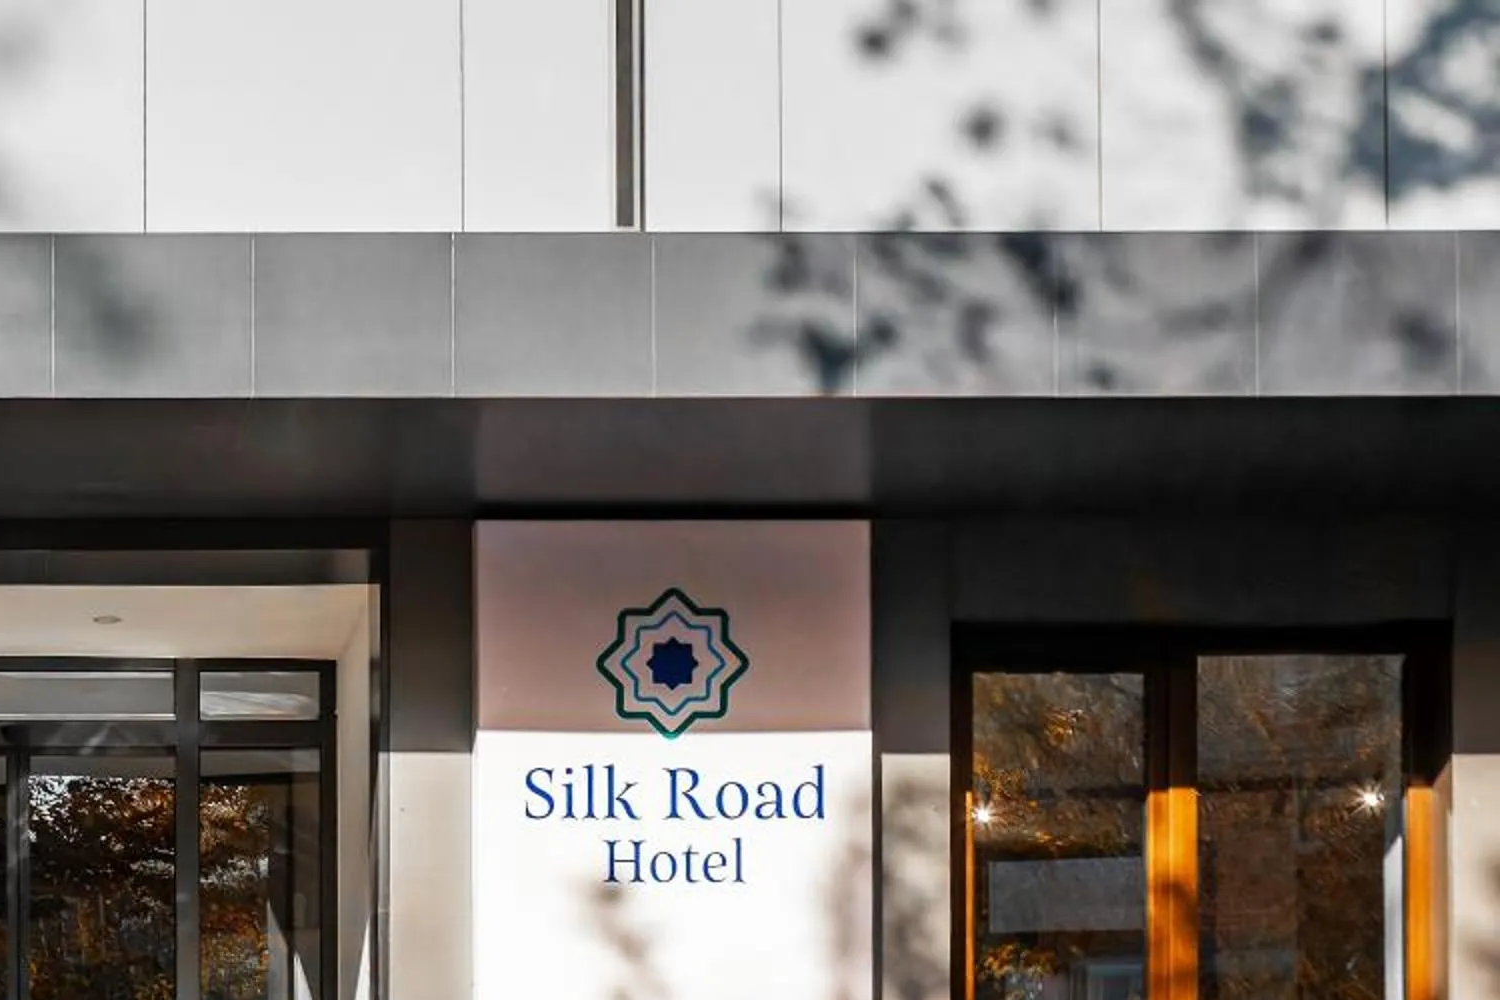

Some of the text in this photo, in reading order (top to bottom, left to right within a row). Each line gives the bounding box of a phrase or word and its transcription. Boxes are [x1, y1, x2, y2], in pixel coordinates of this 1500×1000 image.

[524, 764, 825, 821] Silk Road
[603, 837, 745, 883] Hotel
